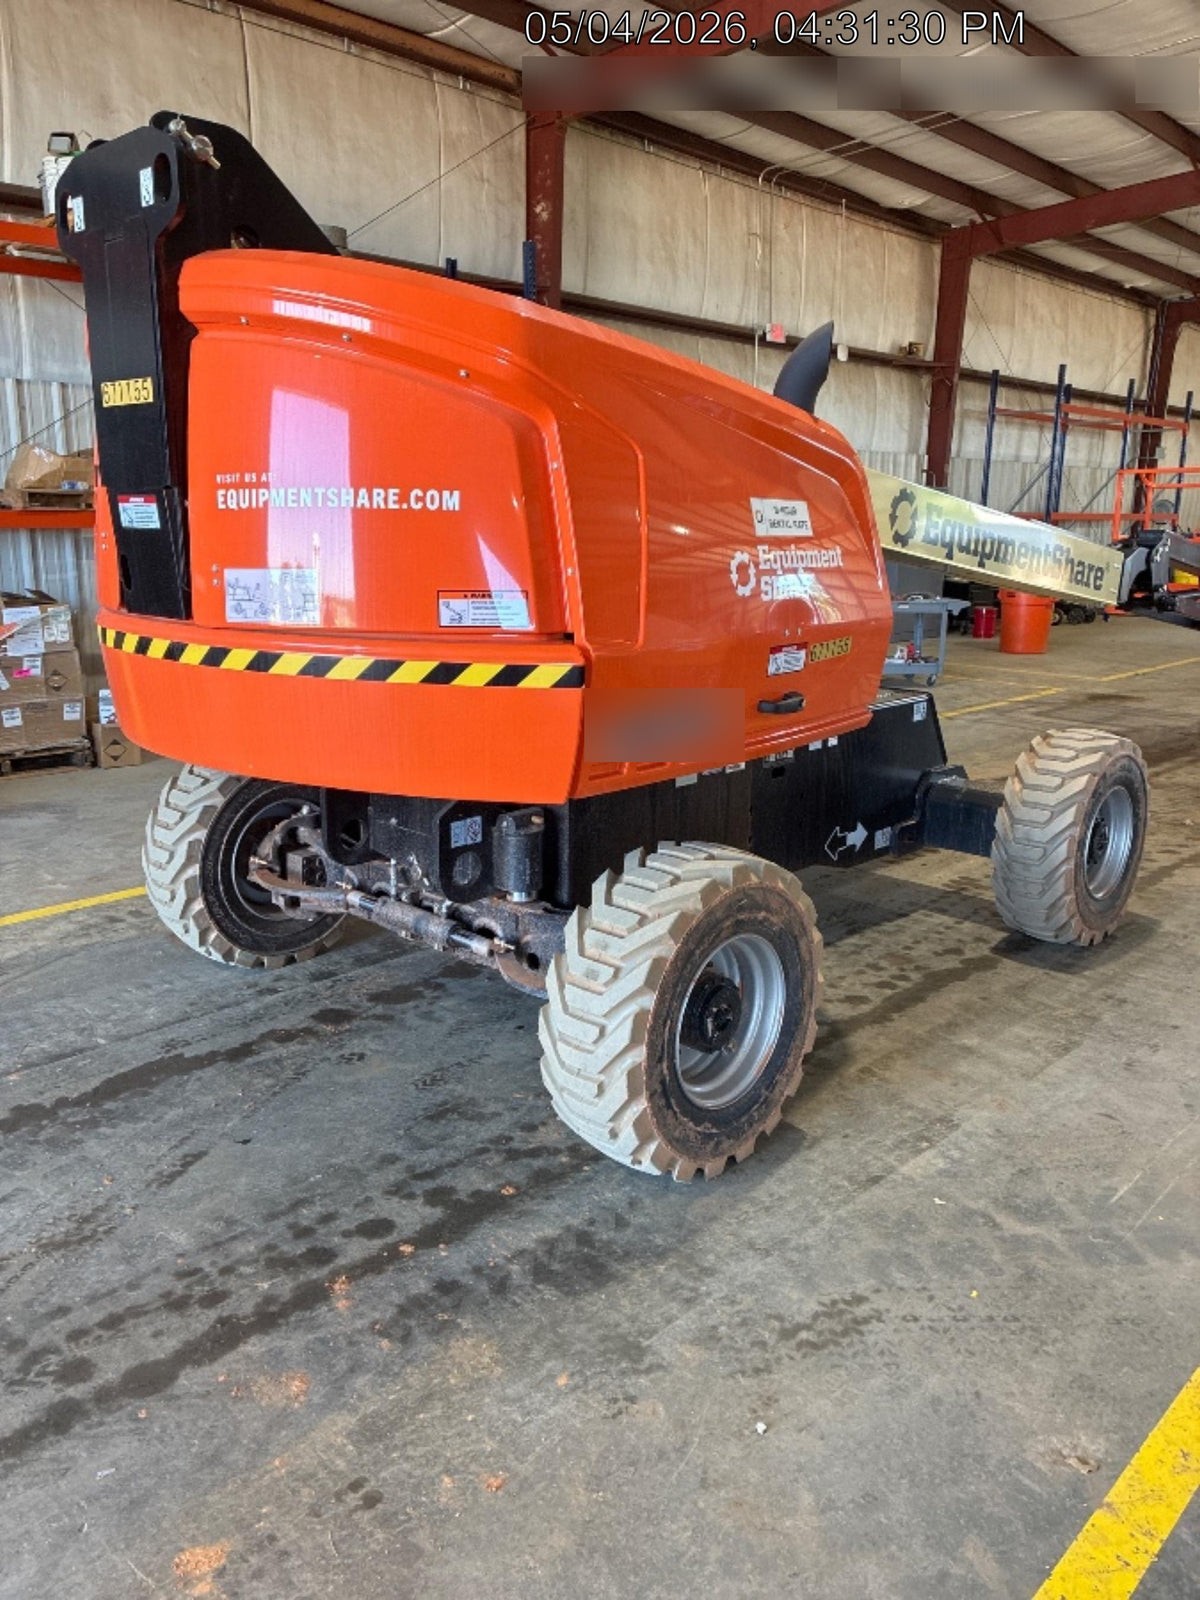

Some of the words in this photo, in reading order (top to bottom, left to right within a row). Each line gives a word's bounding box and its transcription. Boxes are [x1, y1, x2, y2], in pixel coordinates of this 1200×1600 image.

[216, 473, 240, 484] VISIT
[245, 472, 257, 483] US
[216, 487, 461, 511] EQUIPMENTSHARE.COM
[757, 544, 843, 575] Equipment
[922, 502, 1105, 591] EquipmentShare
